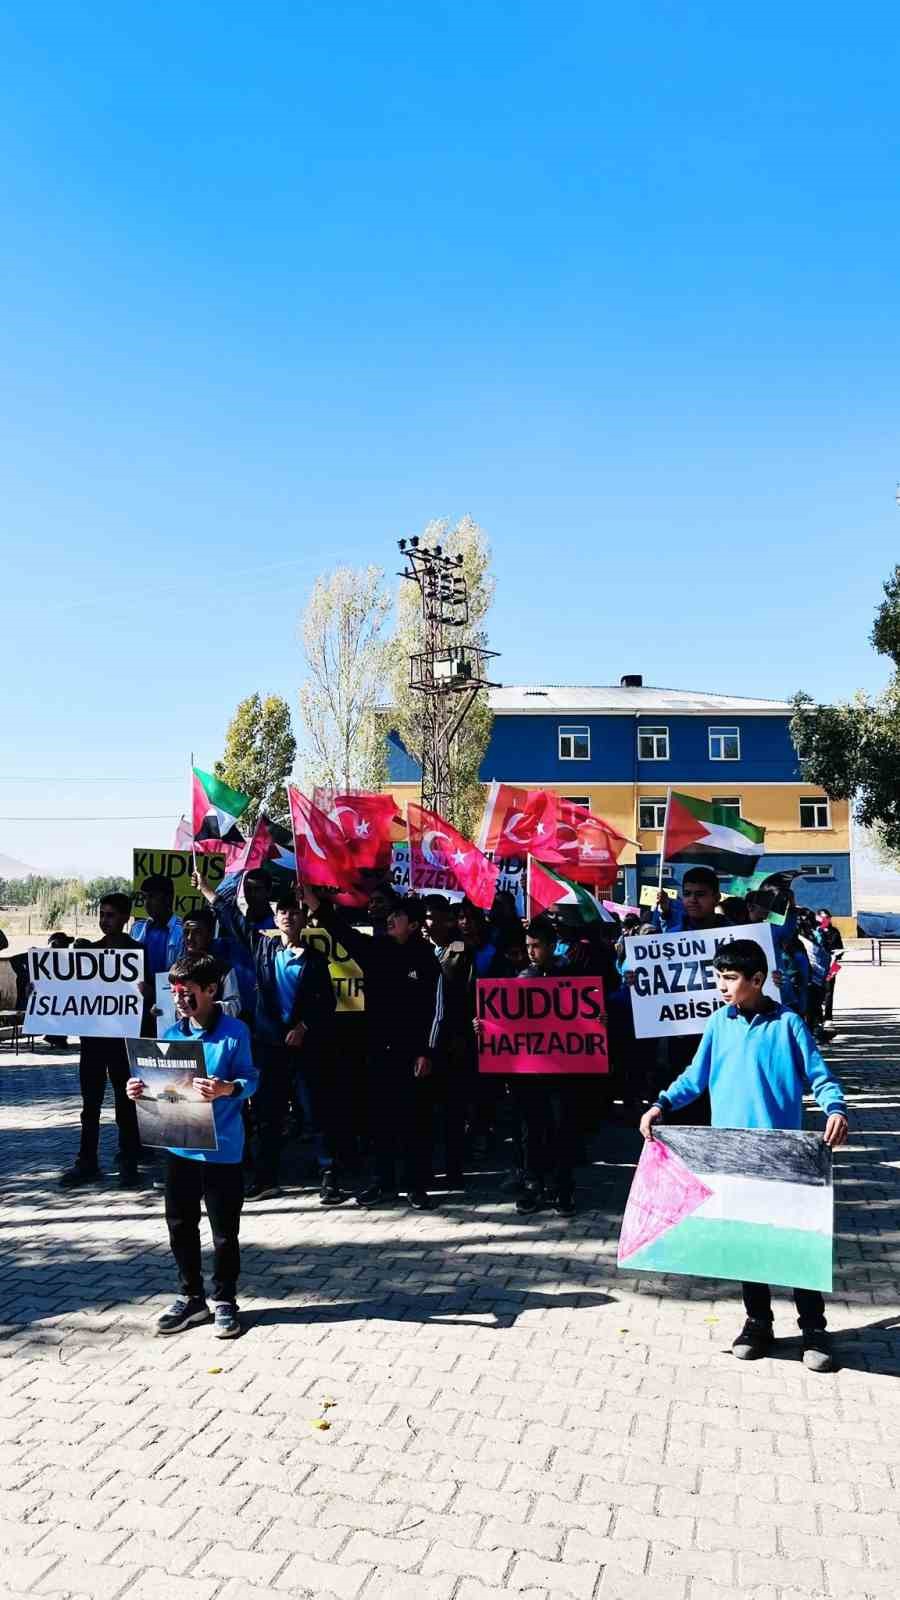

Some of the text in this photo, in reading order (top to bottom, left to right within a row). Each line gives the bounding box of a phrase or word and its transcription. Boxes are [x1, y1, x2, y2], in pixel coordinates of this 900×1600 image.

[634, 938, 706, 960] DÜŞÜN
[32, 949, 139, 983] KUDÜS
[634, 959, 717, 997] GAZZE
[29, 991, 139, 1016] İSLAMDIR
[479, 981, 601, 1020] KUDÜS
[479, 1032, 607, 1056] HAFIZADIR
